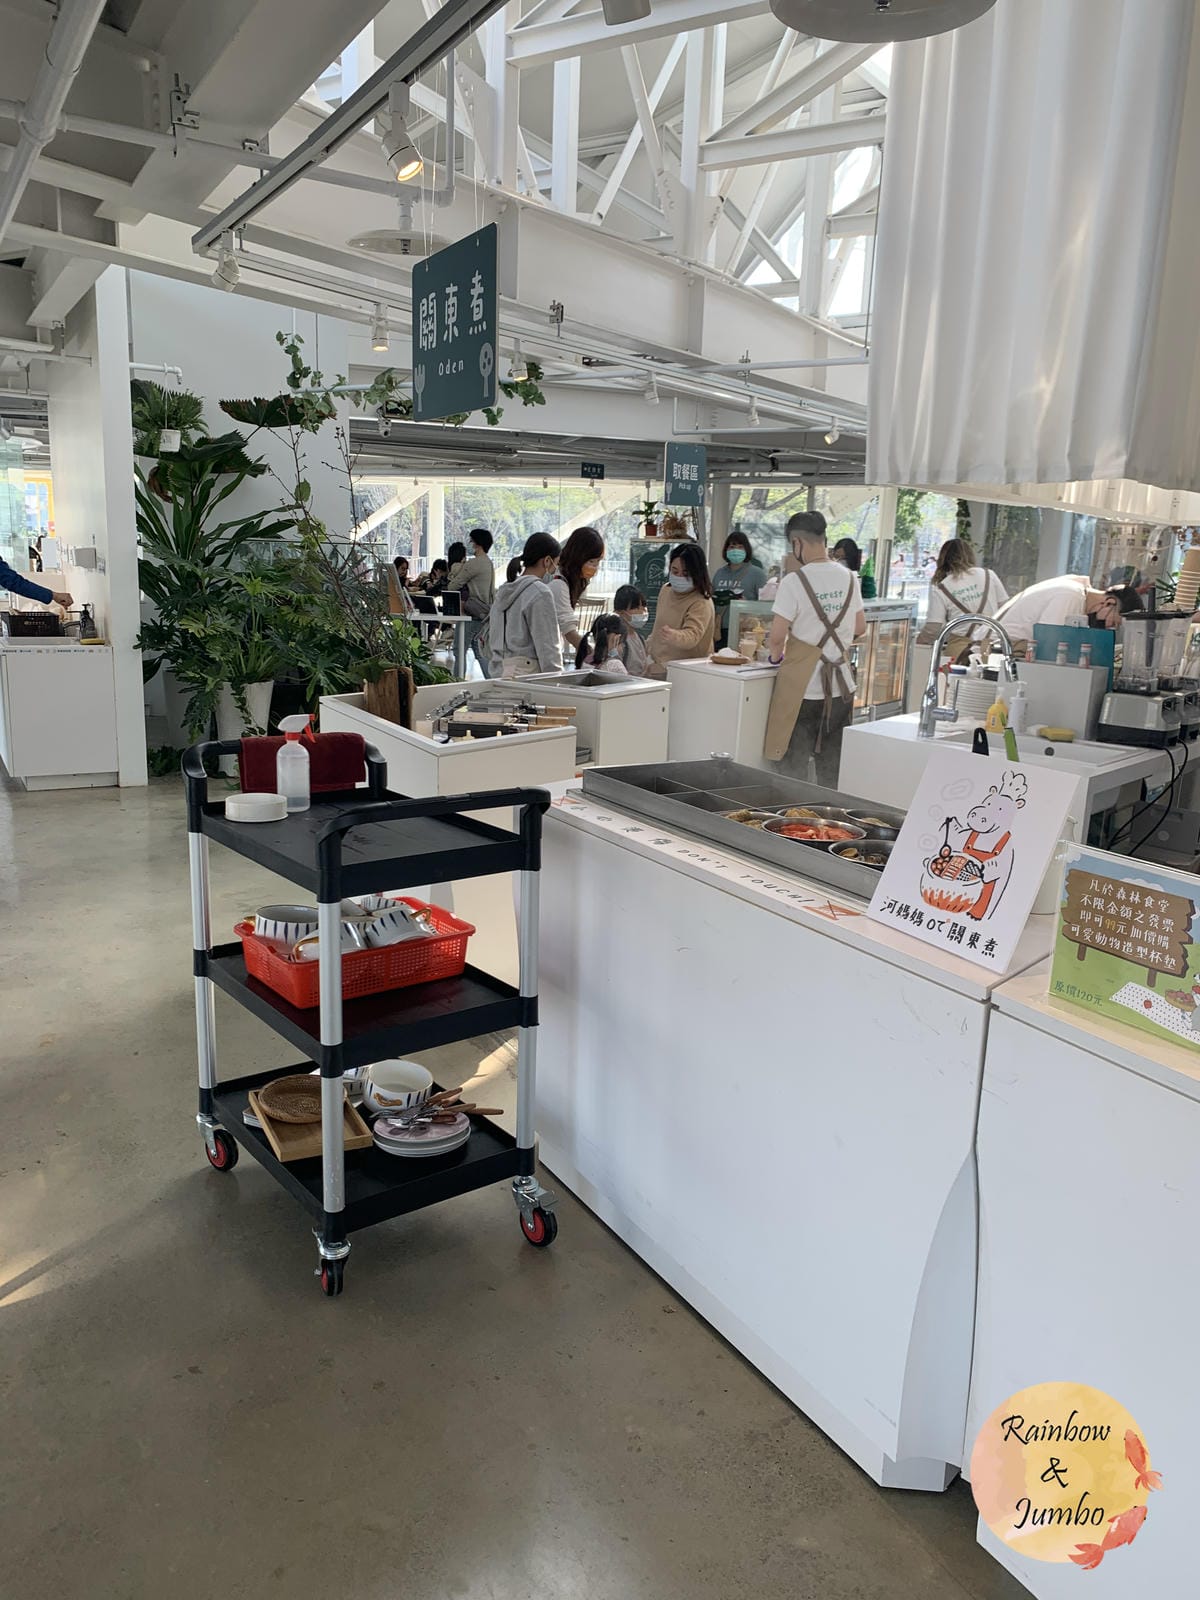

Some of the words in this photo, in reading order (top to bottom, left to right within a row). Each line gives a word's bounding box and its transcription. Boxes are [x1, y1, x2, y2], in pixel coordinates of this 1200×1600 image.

[419, 270, 487, 351] 關東煮
[438, 358, 464, 376] Oden
[672, 462, 699, 481] 取餐區
[1080, 893, 1174, 934] 不限金額之發票
[1089, 878, 1170, 914] 凡於森林食堂
[1071, 923, 1177, 971] 可愛動物造型杯墊
[1080, 909, 1170, 950] 即可99元加價購
